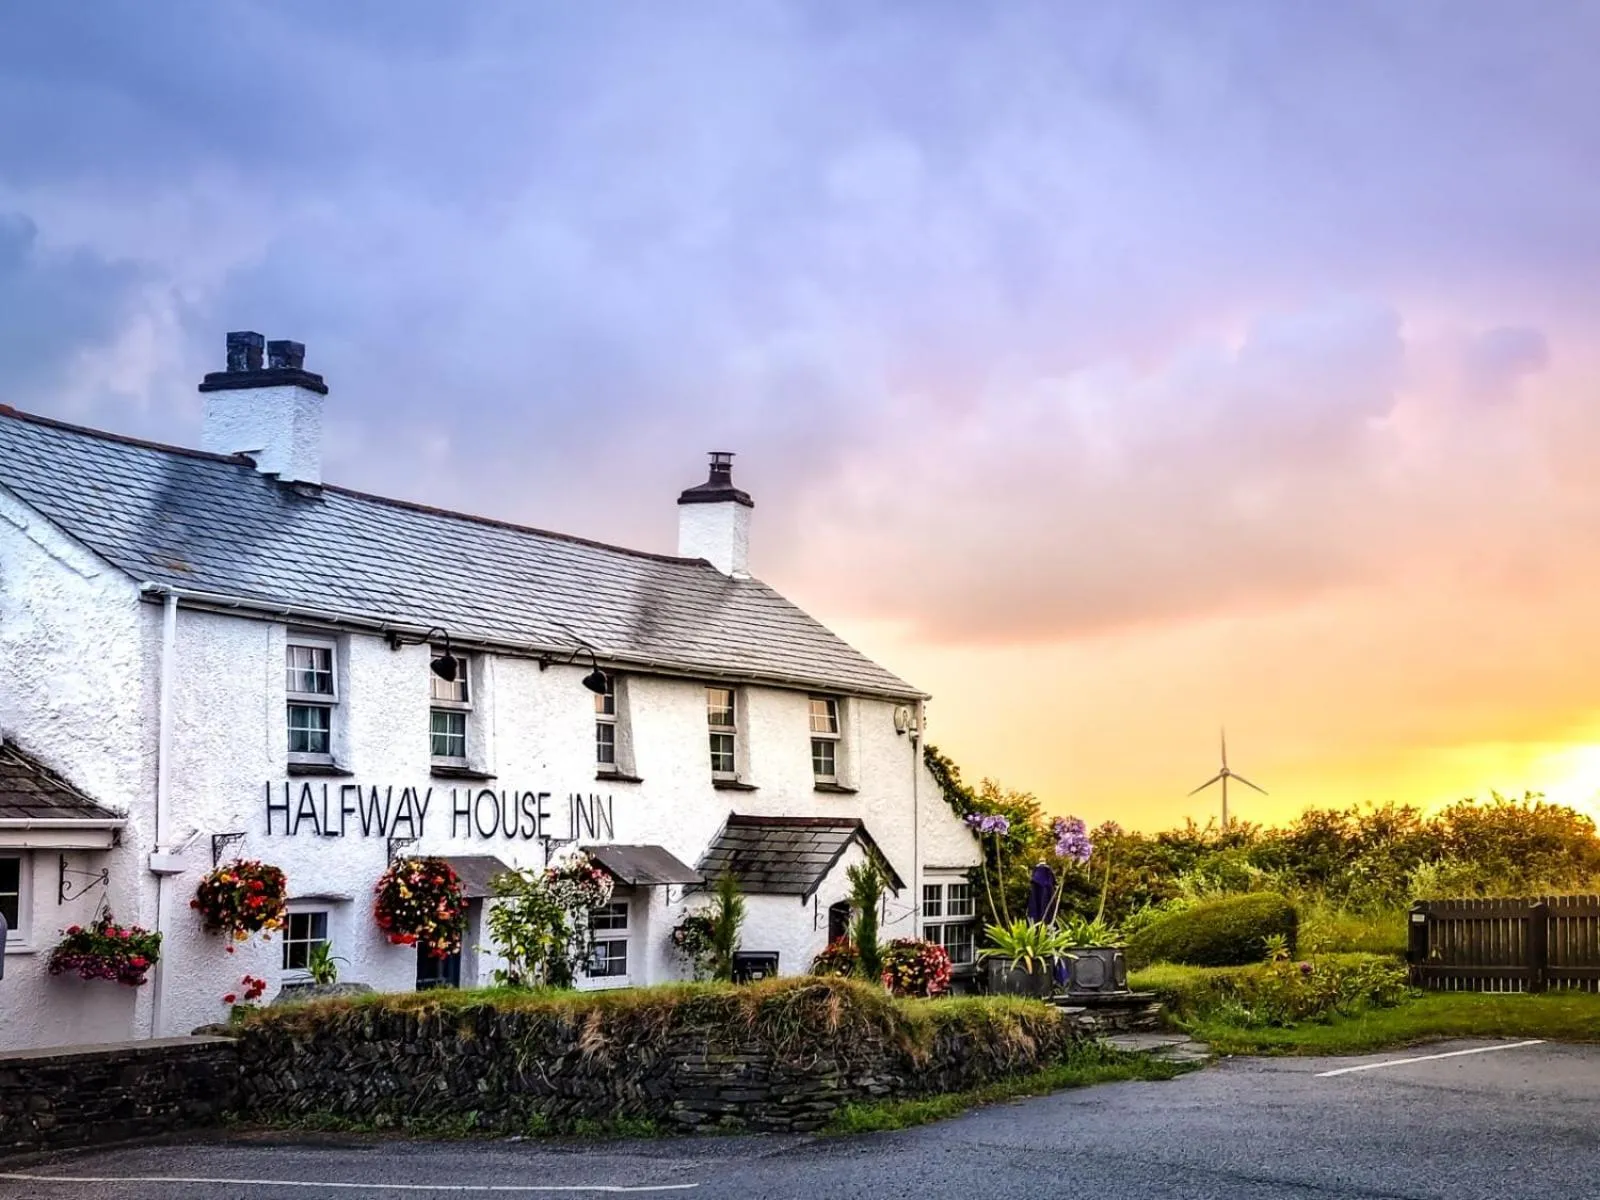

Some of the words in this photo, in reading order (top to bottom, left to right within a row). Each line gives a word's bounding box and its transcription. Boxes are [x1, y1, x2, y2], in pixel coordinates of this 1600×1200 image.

[266, 781, 432, 837] HALFWAY
[453, 788, 551, 839] HOUSE
[569, 793, 614, 839] INN
